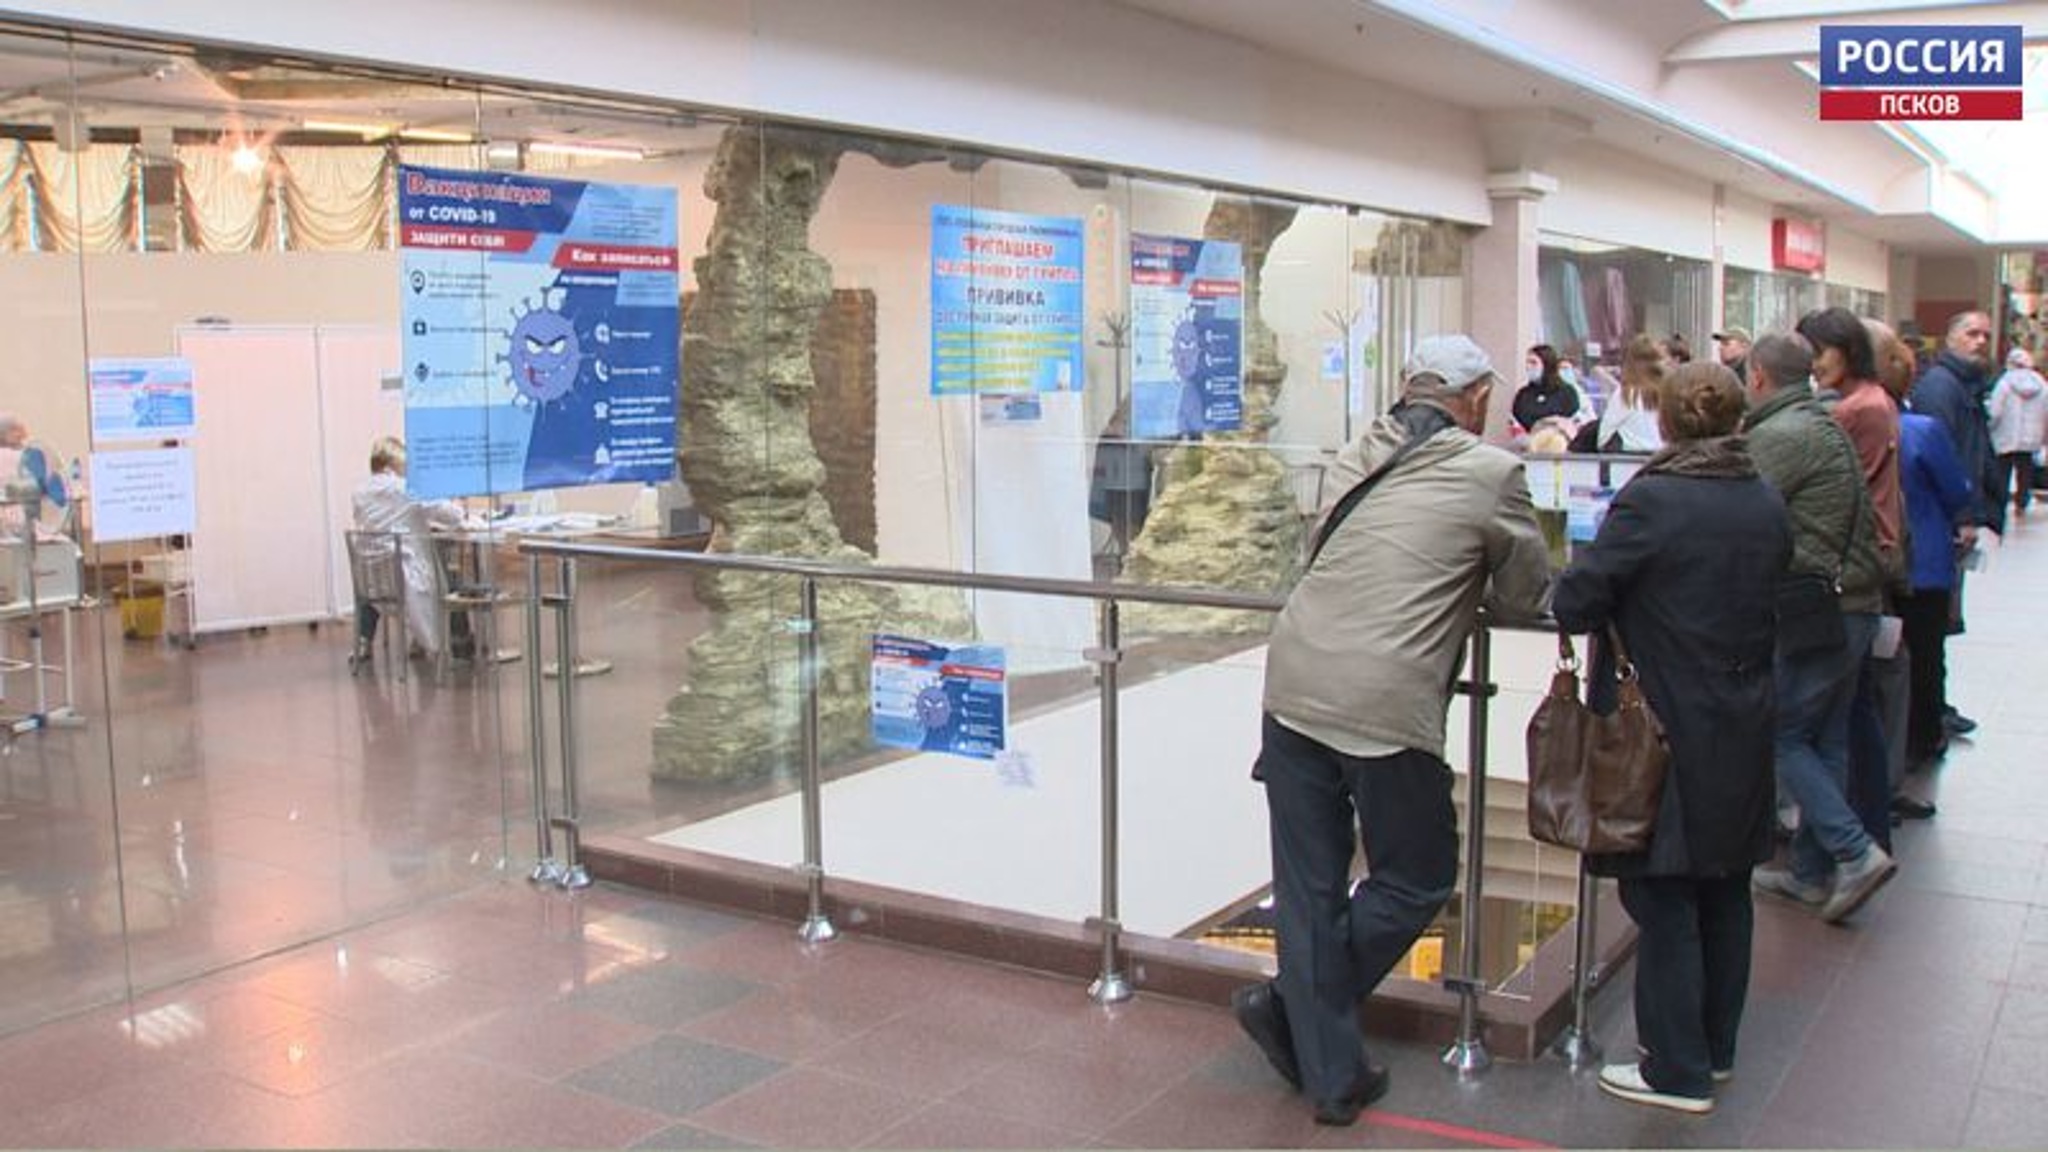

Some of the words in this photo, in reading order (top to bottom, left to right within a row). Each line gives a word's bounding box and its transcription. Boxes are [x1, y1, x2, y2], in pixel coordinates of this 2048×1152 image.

[409, 208, 425, 220] от
[428, 205, 497, 224] COVID-19
[410, 229, 468, 247] ЗАЩИТИ
[961, 234, 1054, 258] ПРИГЛАШАЕМ
[571, 247, 597, 262] Как
[1015, 264, 1031, 280] ОТ
[966, 285, 1046, 305] ПРИВИВКА
